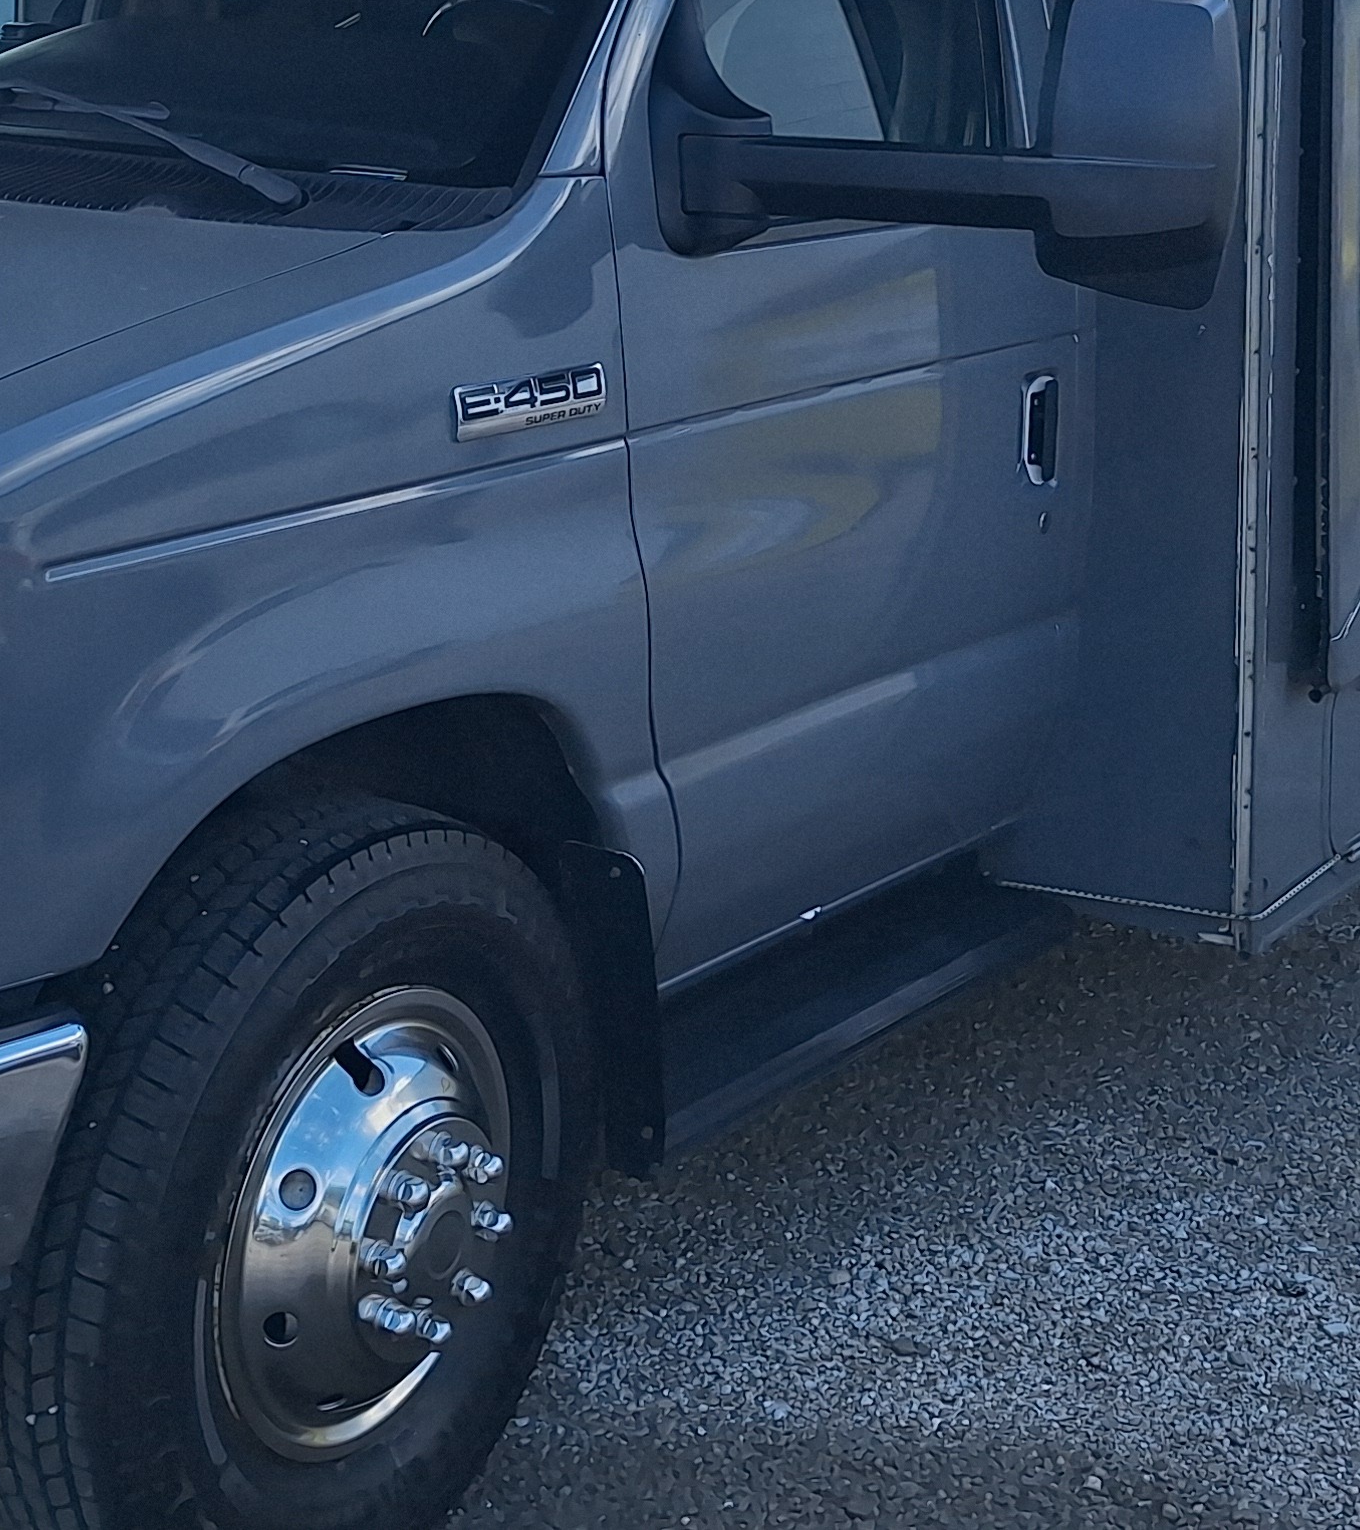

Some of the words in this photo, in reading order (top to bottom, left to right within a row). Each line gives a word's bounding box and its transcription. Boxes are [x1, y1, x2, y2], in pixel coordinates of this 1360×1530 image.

[459, 367, 603, 421] E-450
[525, 410, 566, 426] SUPER
[569, 403, 602, 417] DUTY
